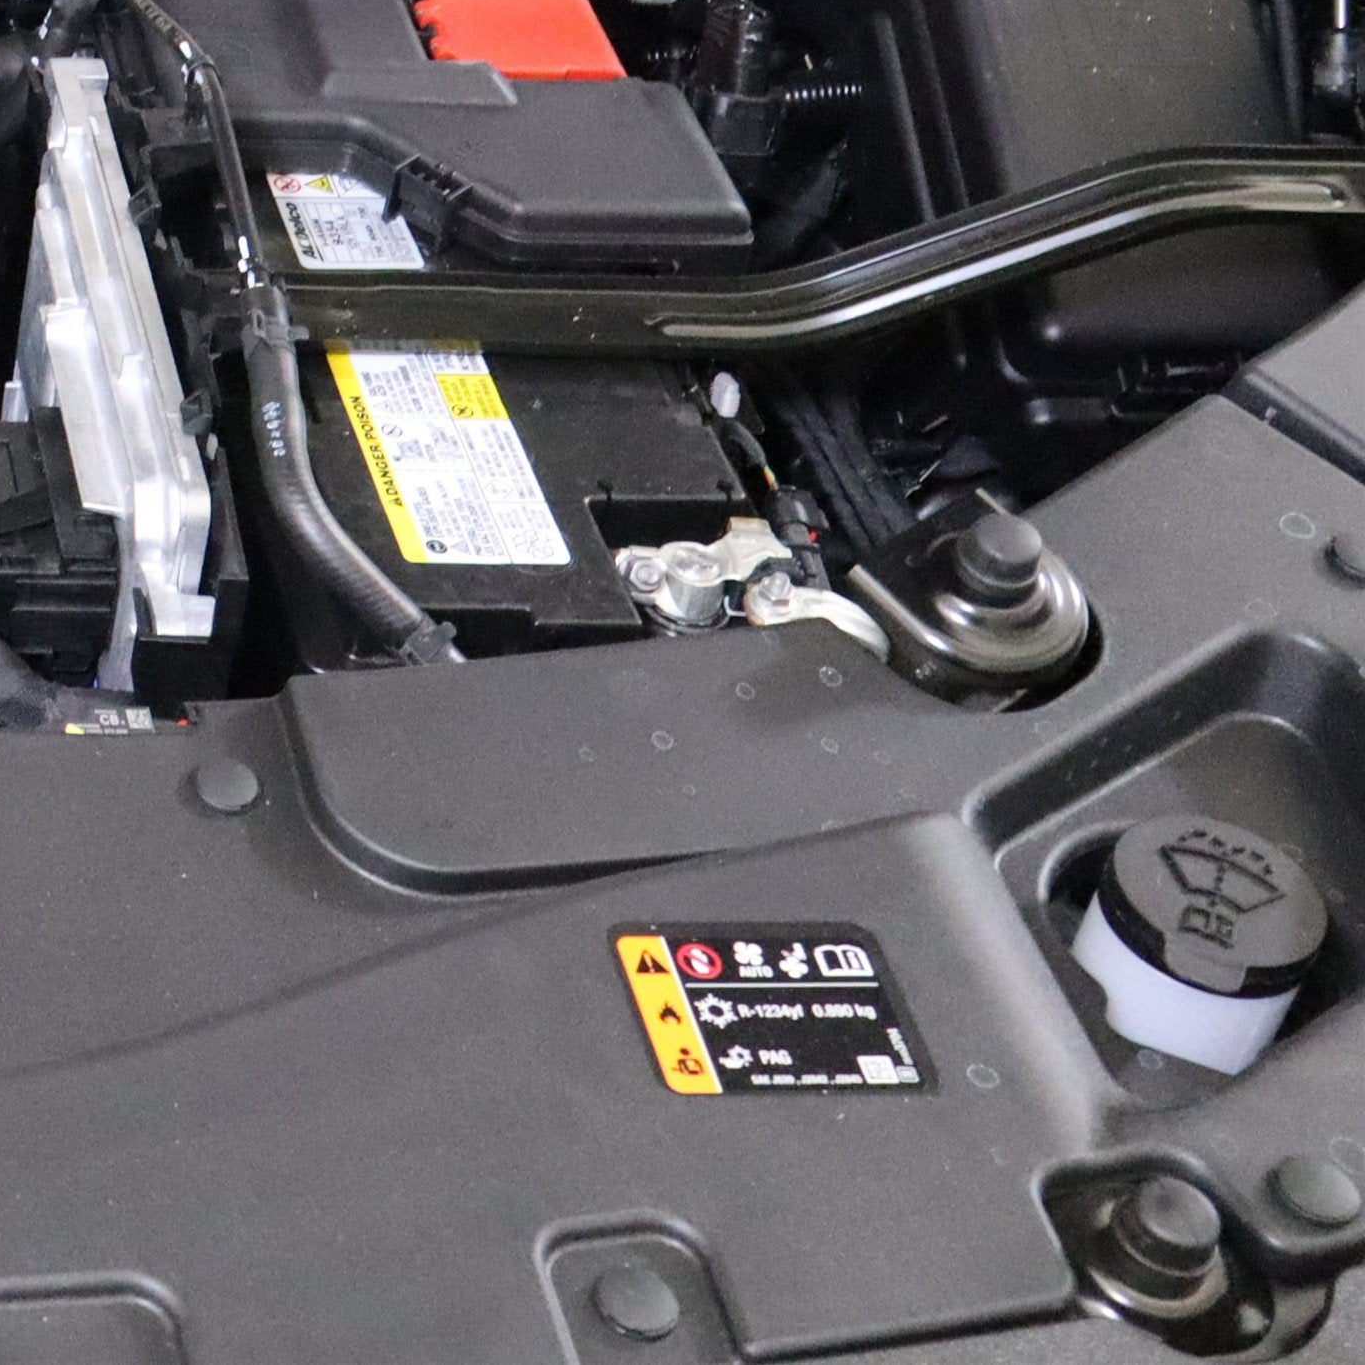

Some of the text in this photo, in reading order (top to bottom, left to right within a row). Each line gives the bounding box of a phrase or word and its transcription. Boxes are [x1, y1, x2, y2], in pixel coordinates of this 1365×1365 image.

[350, 396, 398, 501] DANGER POISON
[739, 965, 774, 978] AUTO
[737, 1003, 804, 1020] R-1234yf
[854, 1003, 877, 1020] kg
[758, 1049, 793, 1065] PAG
